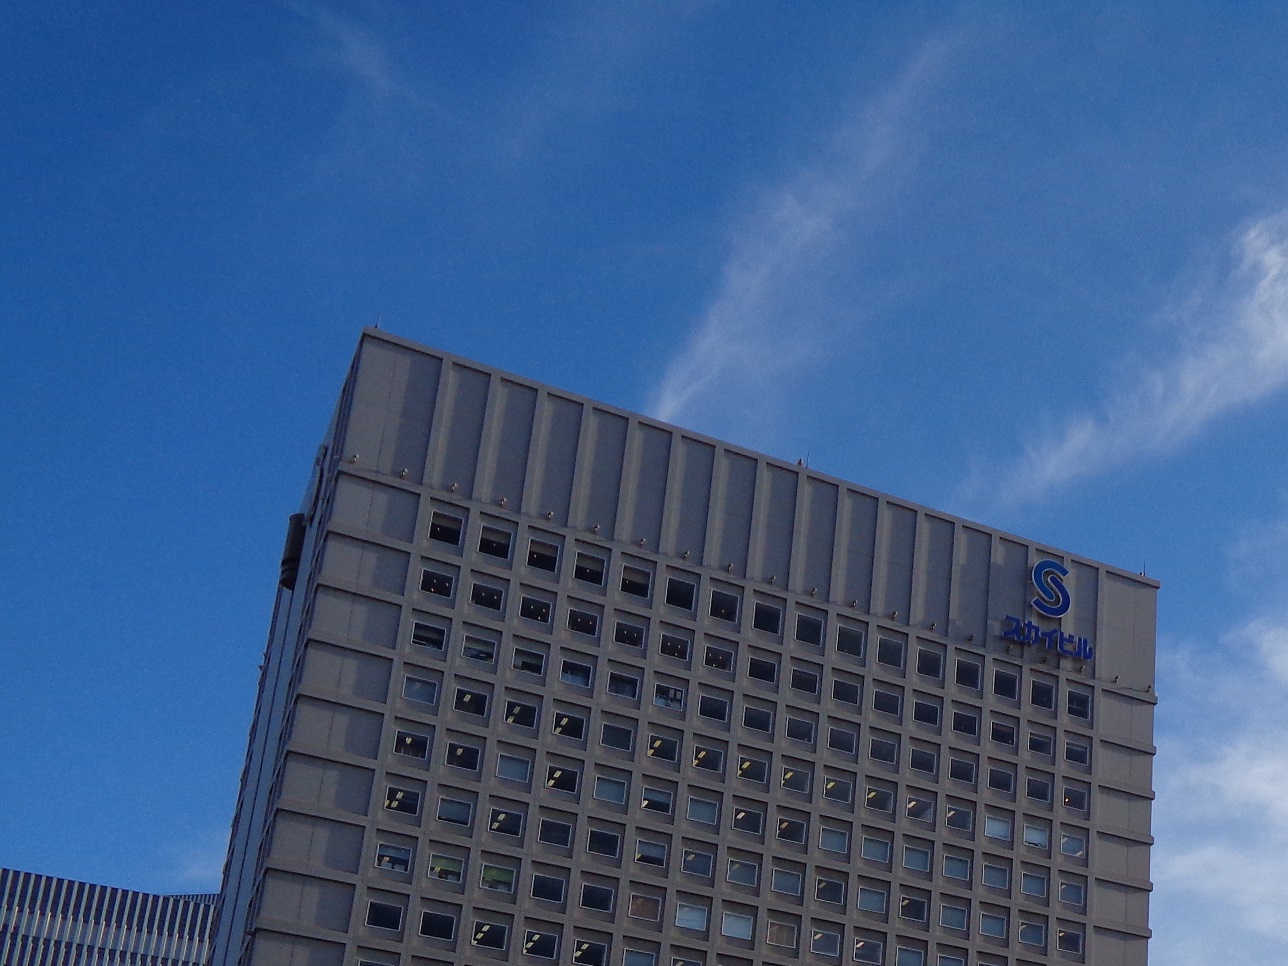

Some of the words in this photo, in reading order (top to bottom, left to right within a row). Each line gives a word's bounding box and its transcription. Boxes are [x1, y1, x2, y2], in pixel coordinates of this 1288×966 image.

[1002, 614, 1094, 662] スカイビル
